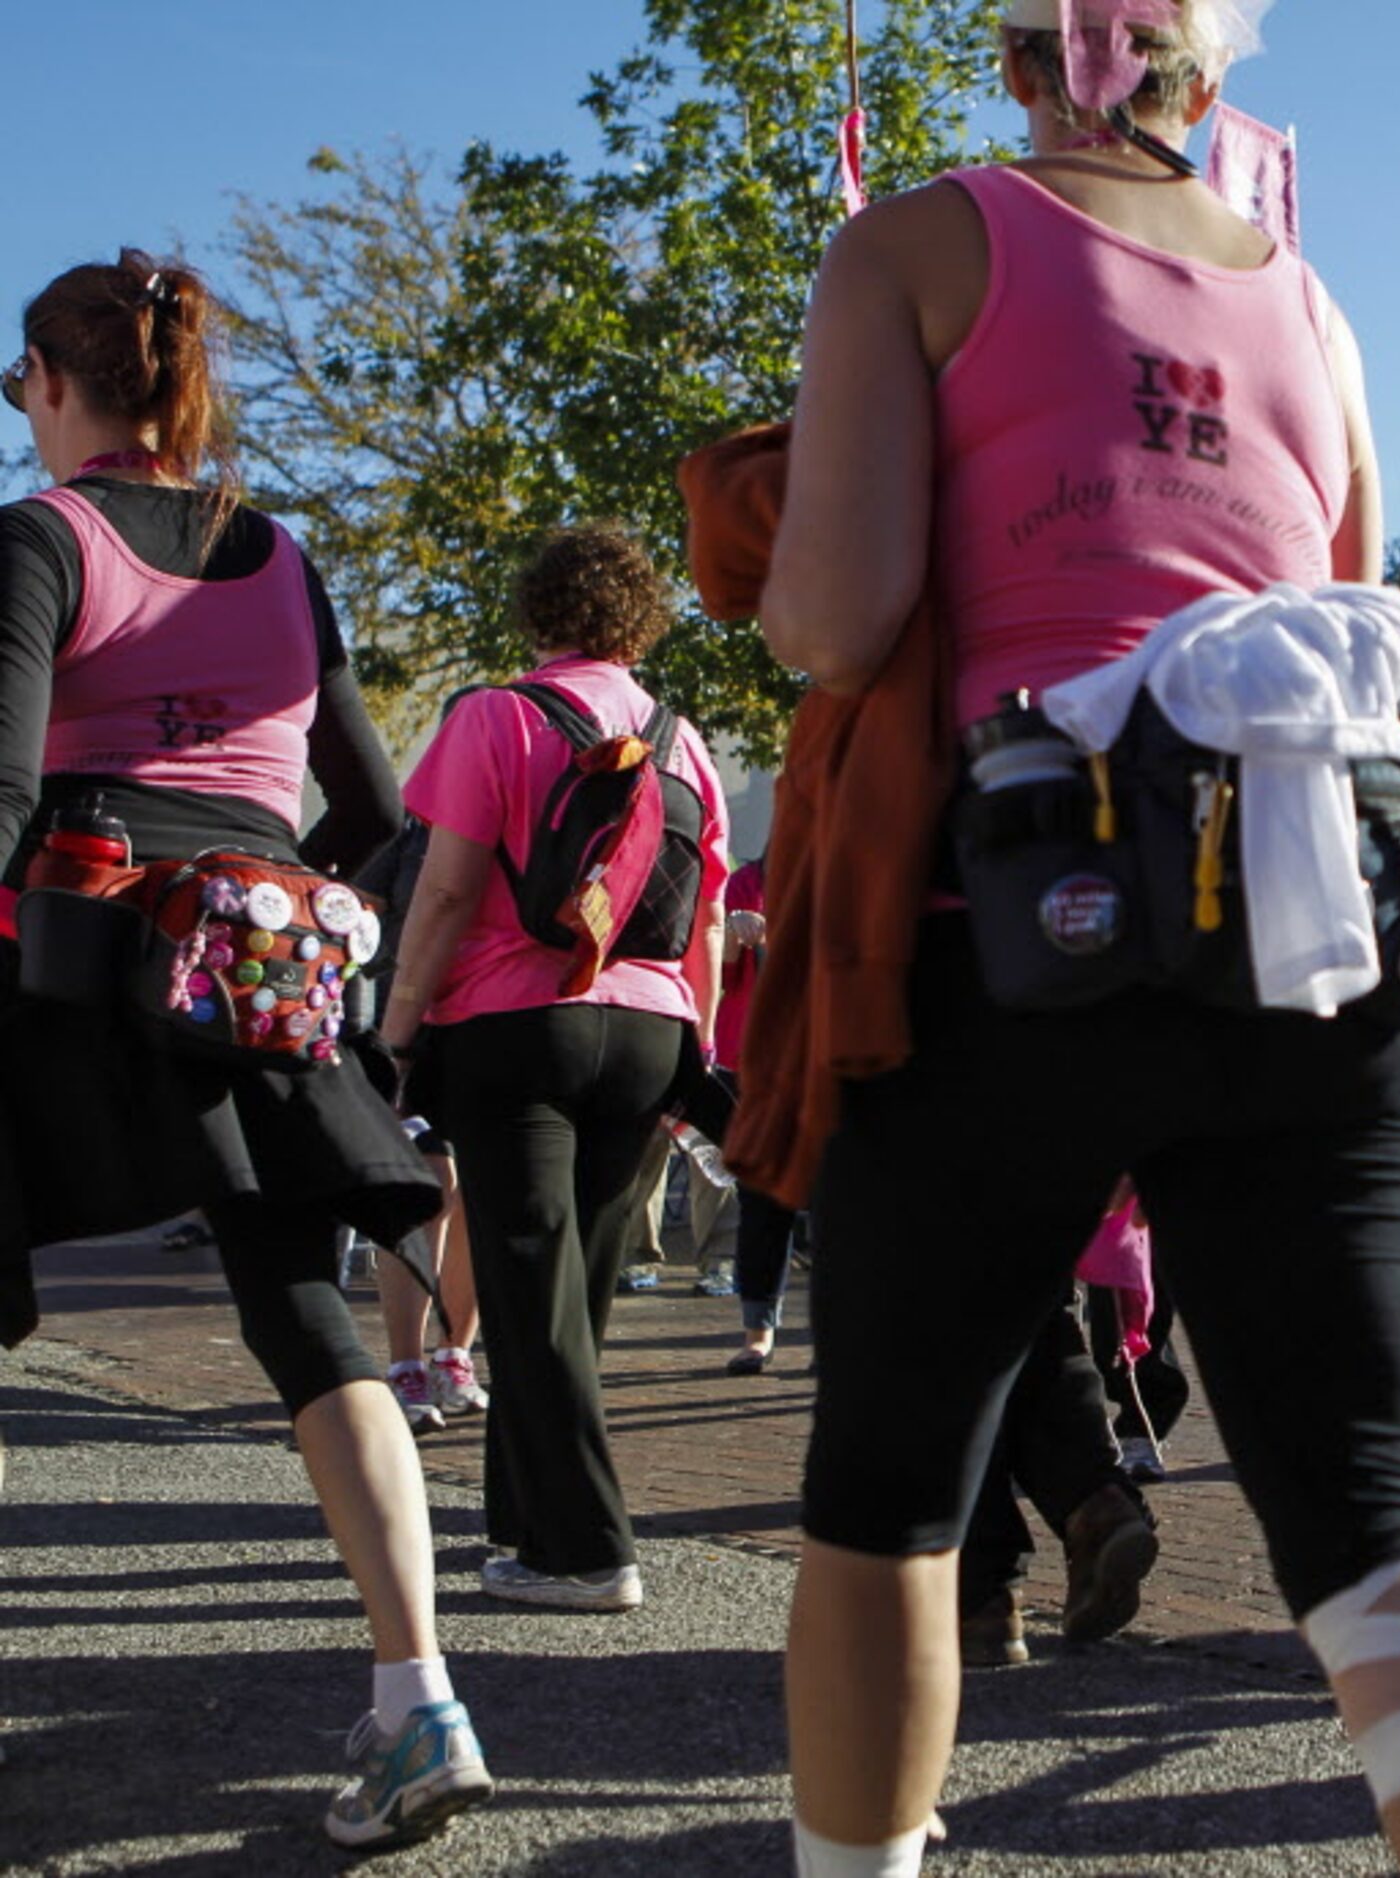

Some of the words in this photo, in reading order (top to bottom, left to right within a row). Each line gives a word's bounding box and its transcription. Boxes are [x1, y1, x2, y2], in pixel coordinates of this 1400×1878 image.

[1130, 351, 1165, 397] I
[1133, 401, 1228, 467] YE
[1007, 471, 1118, 549] today
[1157, 475, 1218, 505] am
[155, 693, 181, 717] I
